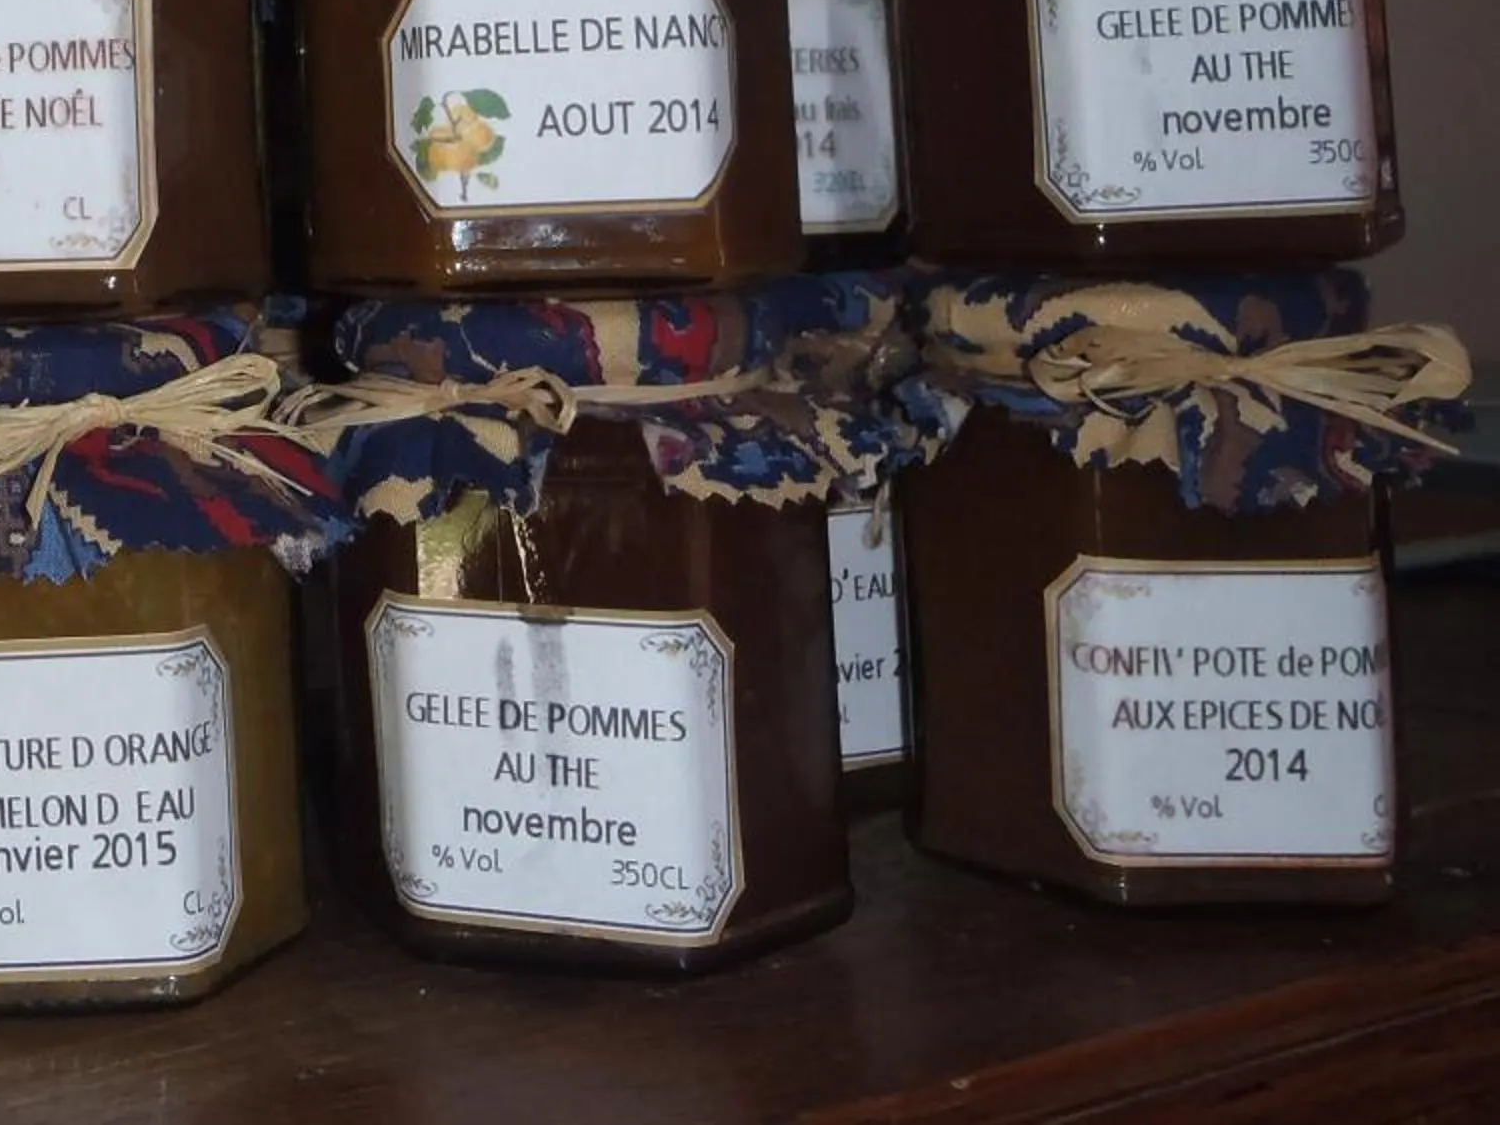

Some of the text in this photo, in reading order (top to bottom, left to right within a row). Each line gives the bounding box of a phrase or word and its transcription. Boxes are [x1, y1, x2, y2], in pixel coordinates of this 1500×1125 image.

[400, 17, 624, 61] MIRABELLE DE
[1097, 7, 1182, 40] GELEE
[1192, 5, 1230, 36] DE
[8, 38, 135, 74] POMMES
[1191, 50, 1294, 84] AU THE
[537, 98, 719, 138] AOUT 2014
[1162, 96, 1332, 136] novembre
[62, 197, 92, 221] CL
[1193, 646, 1268, 677] POTE
[1277, 647, 1314, 677] de
[406, 692, 687, 742] GELEE DE POMMES
[1112, 699, 1328, 731] AUX EPICES DE
[105, 720, 212, 766] ORANGE
[494, 751, 600, 790] AU THE
[1225, 748, 1308, 782] 2014
[97, 792, 118, 825] D
[137, 786, 196, 823] EAU
[462, 805, 637, 847] novembre
[91, 830, 177, 869] 2015
[611, 860, 691, 891] 350CL
[183, 890, 204, 916] CL
